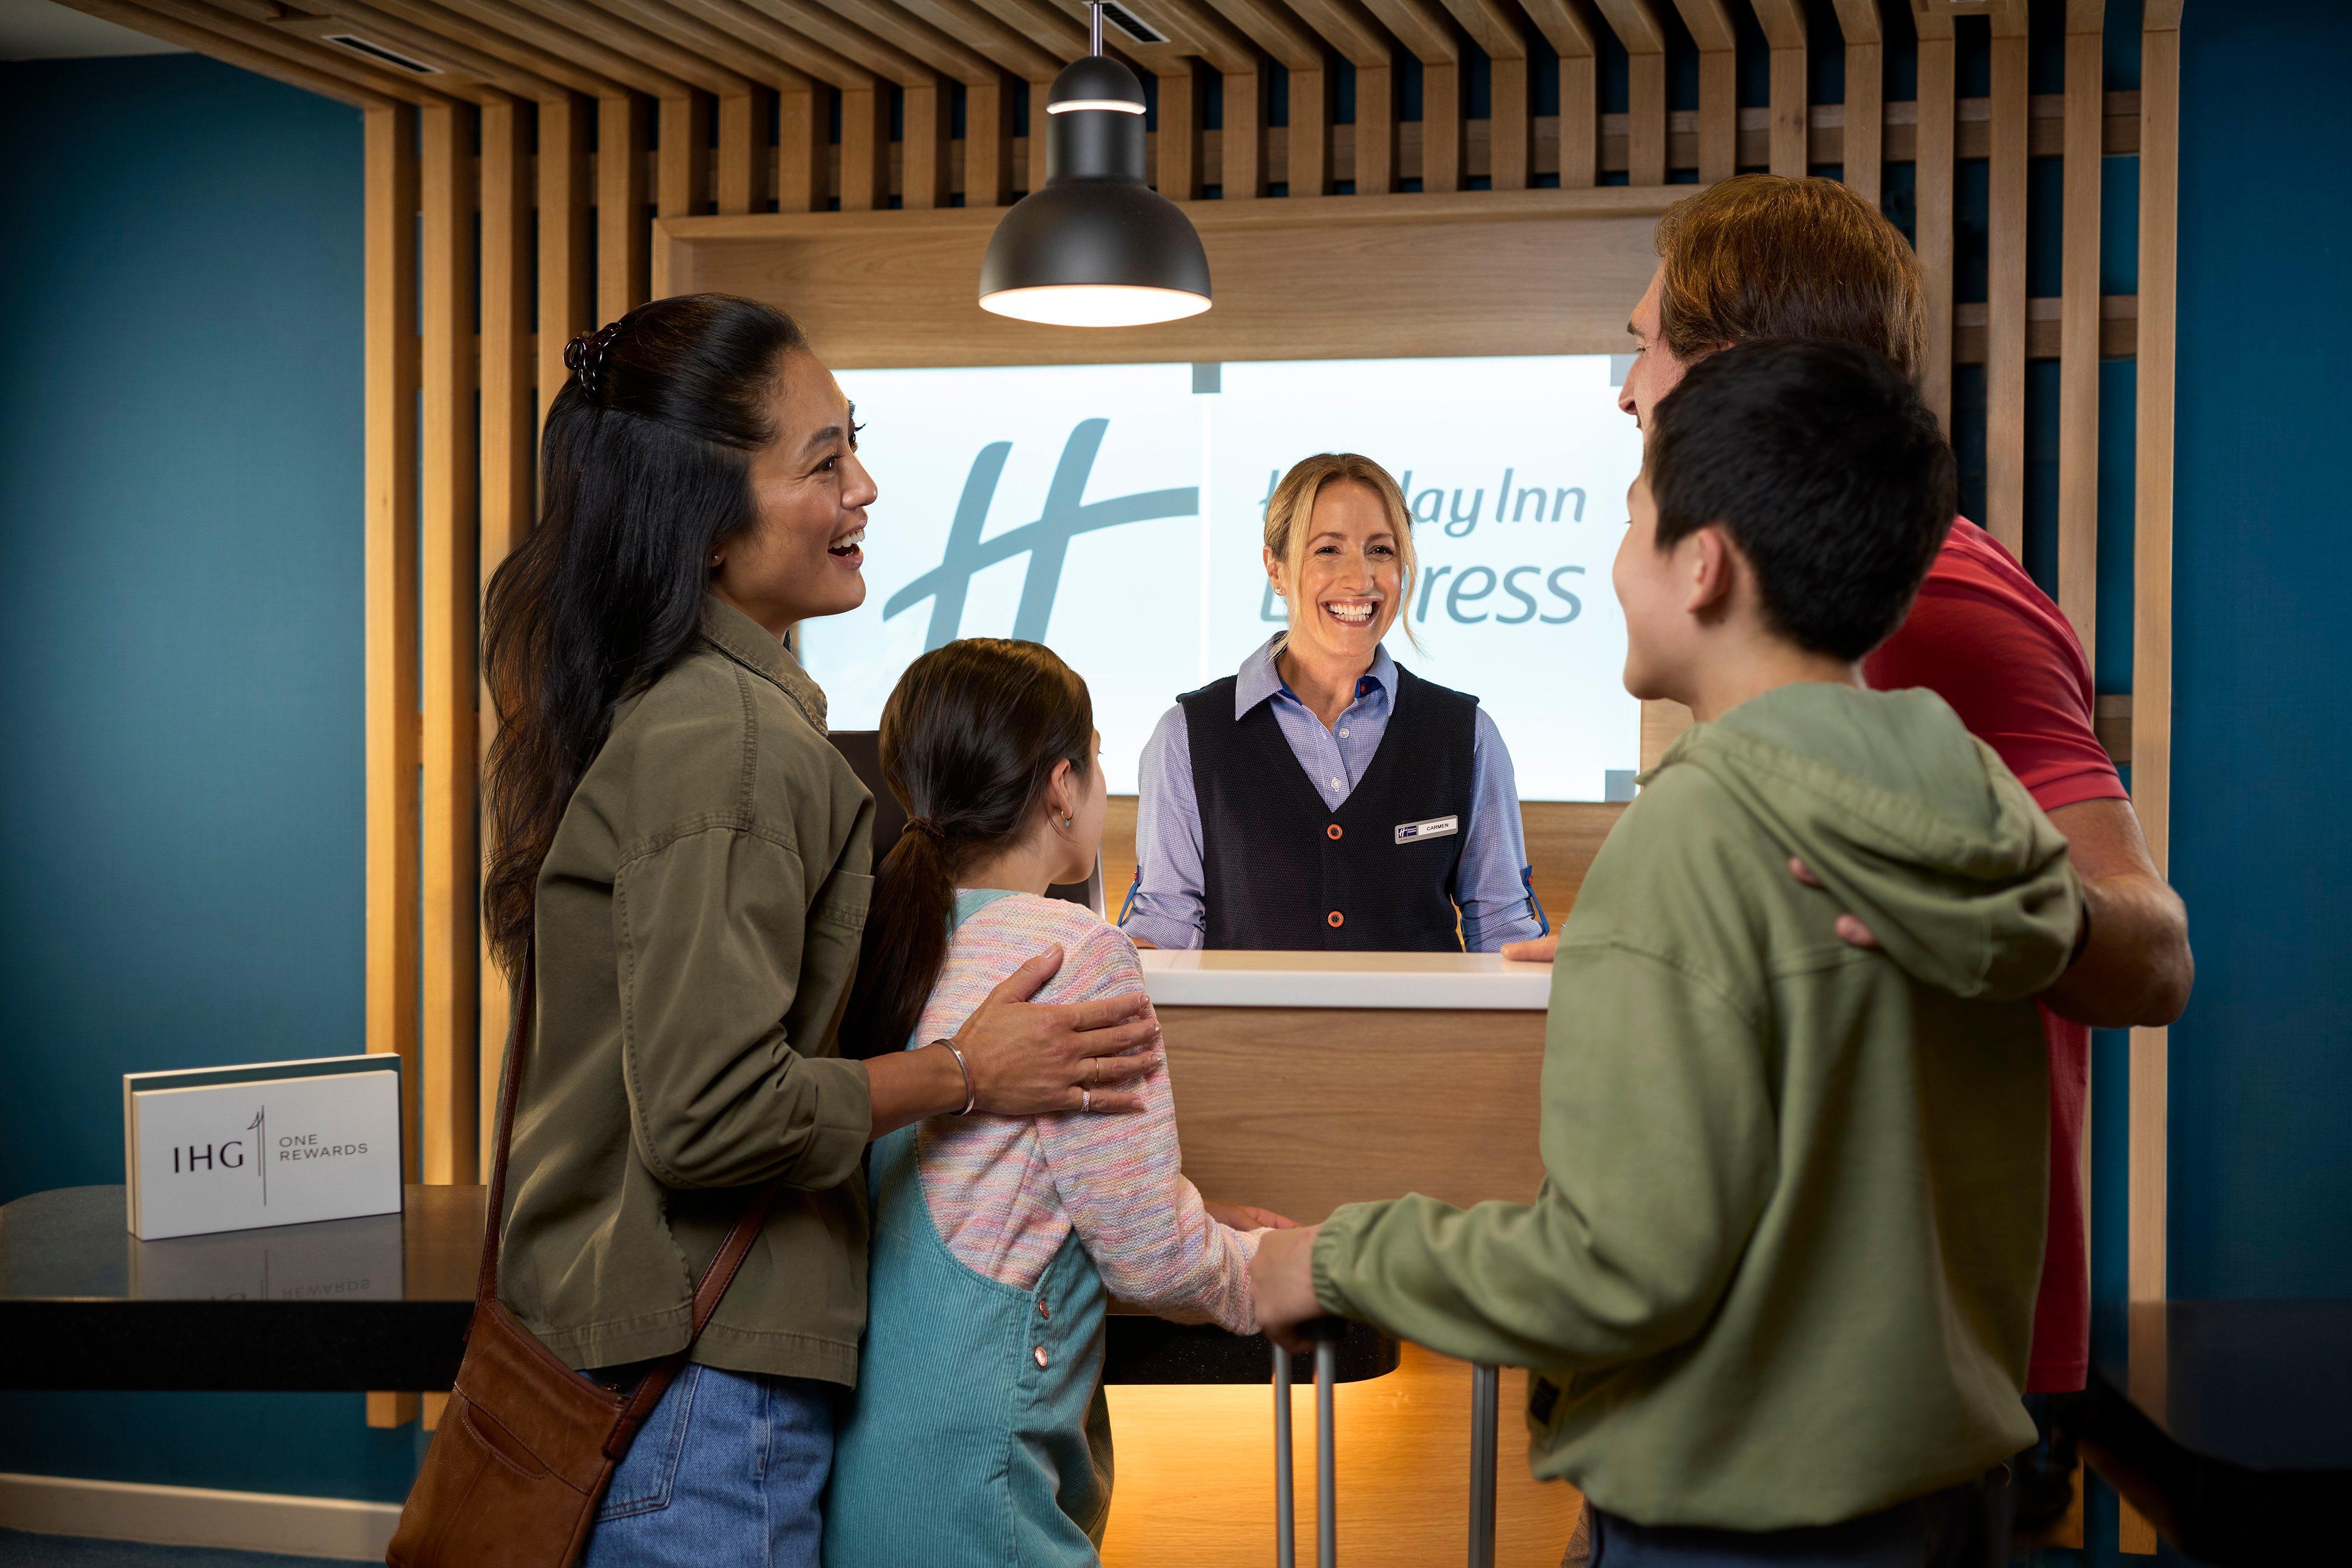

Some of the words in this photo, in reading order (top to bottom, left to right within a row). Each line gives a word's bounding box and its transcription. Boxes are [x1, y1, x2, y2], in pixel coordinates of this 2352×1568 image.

[1496, 469, 1586, 523] Inn
[279, 1134, 318, 1148] ONE
[280, 1144, 368, 1162] REWARDS
[174, 1141, 244, 1174] IHG
